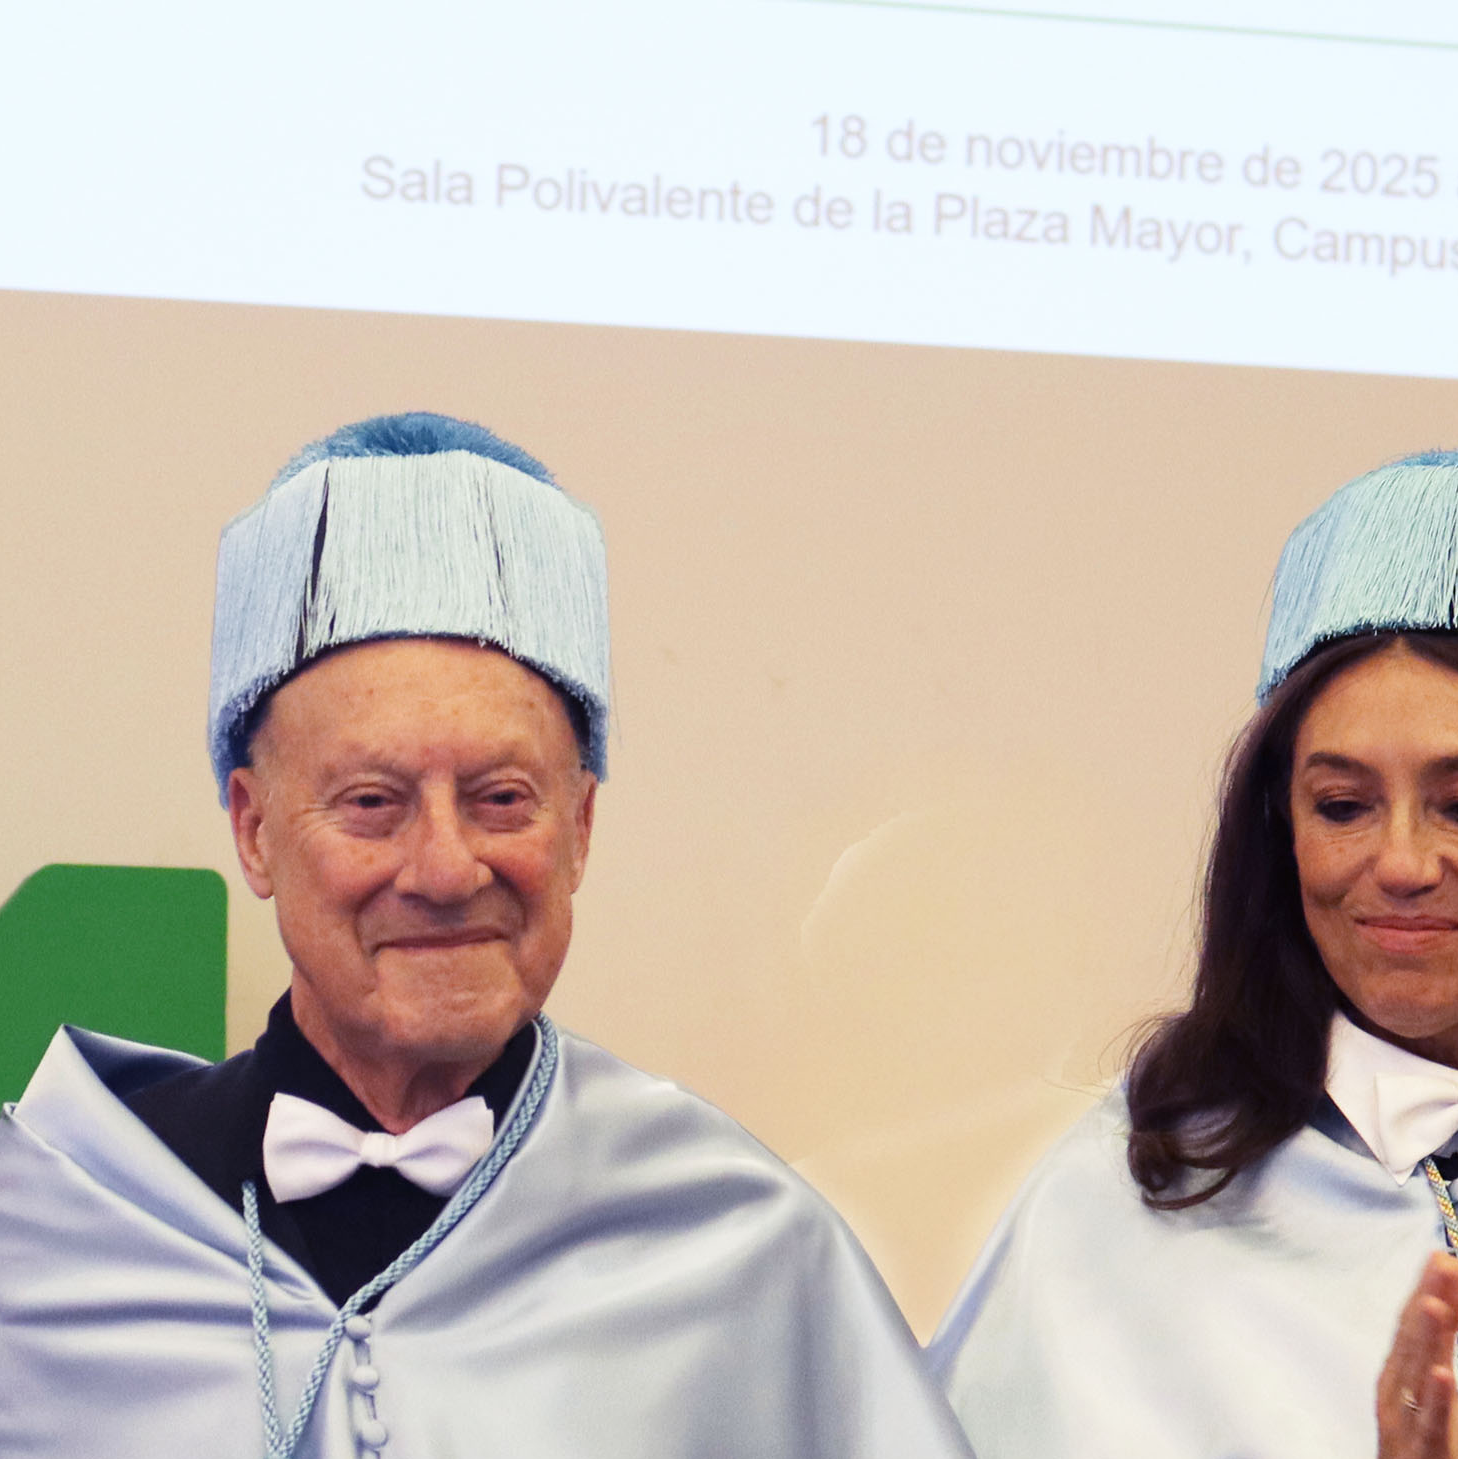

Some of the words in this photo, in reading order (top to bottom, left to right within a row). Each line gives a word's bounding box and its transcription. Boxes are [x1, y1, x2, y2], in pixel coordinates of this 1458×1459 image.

[811, 112, 869, 160] 18
[884, 118, 948, 166] de
[964, 130, 1226, 186] noviembre
[1241, 144, 1303, 191] de
[1318, 147, 1441, 201] 2025
[360, 154, 475, 207] Sala
[495, 162, 776, 226] Polivalente
[791, 184, 856, 232] de
[872, 188, 914, 235] la
[933, 191, 1071, 246] Plaza
[1089, 202, 1252, 264] Mayor,
